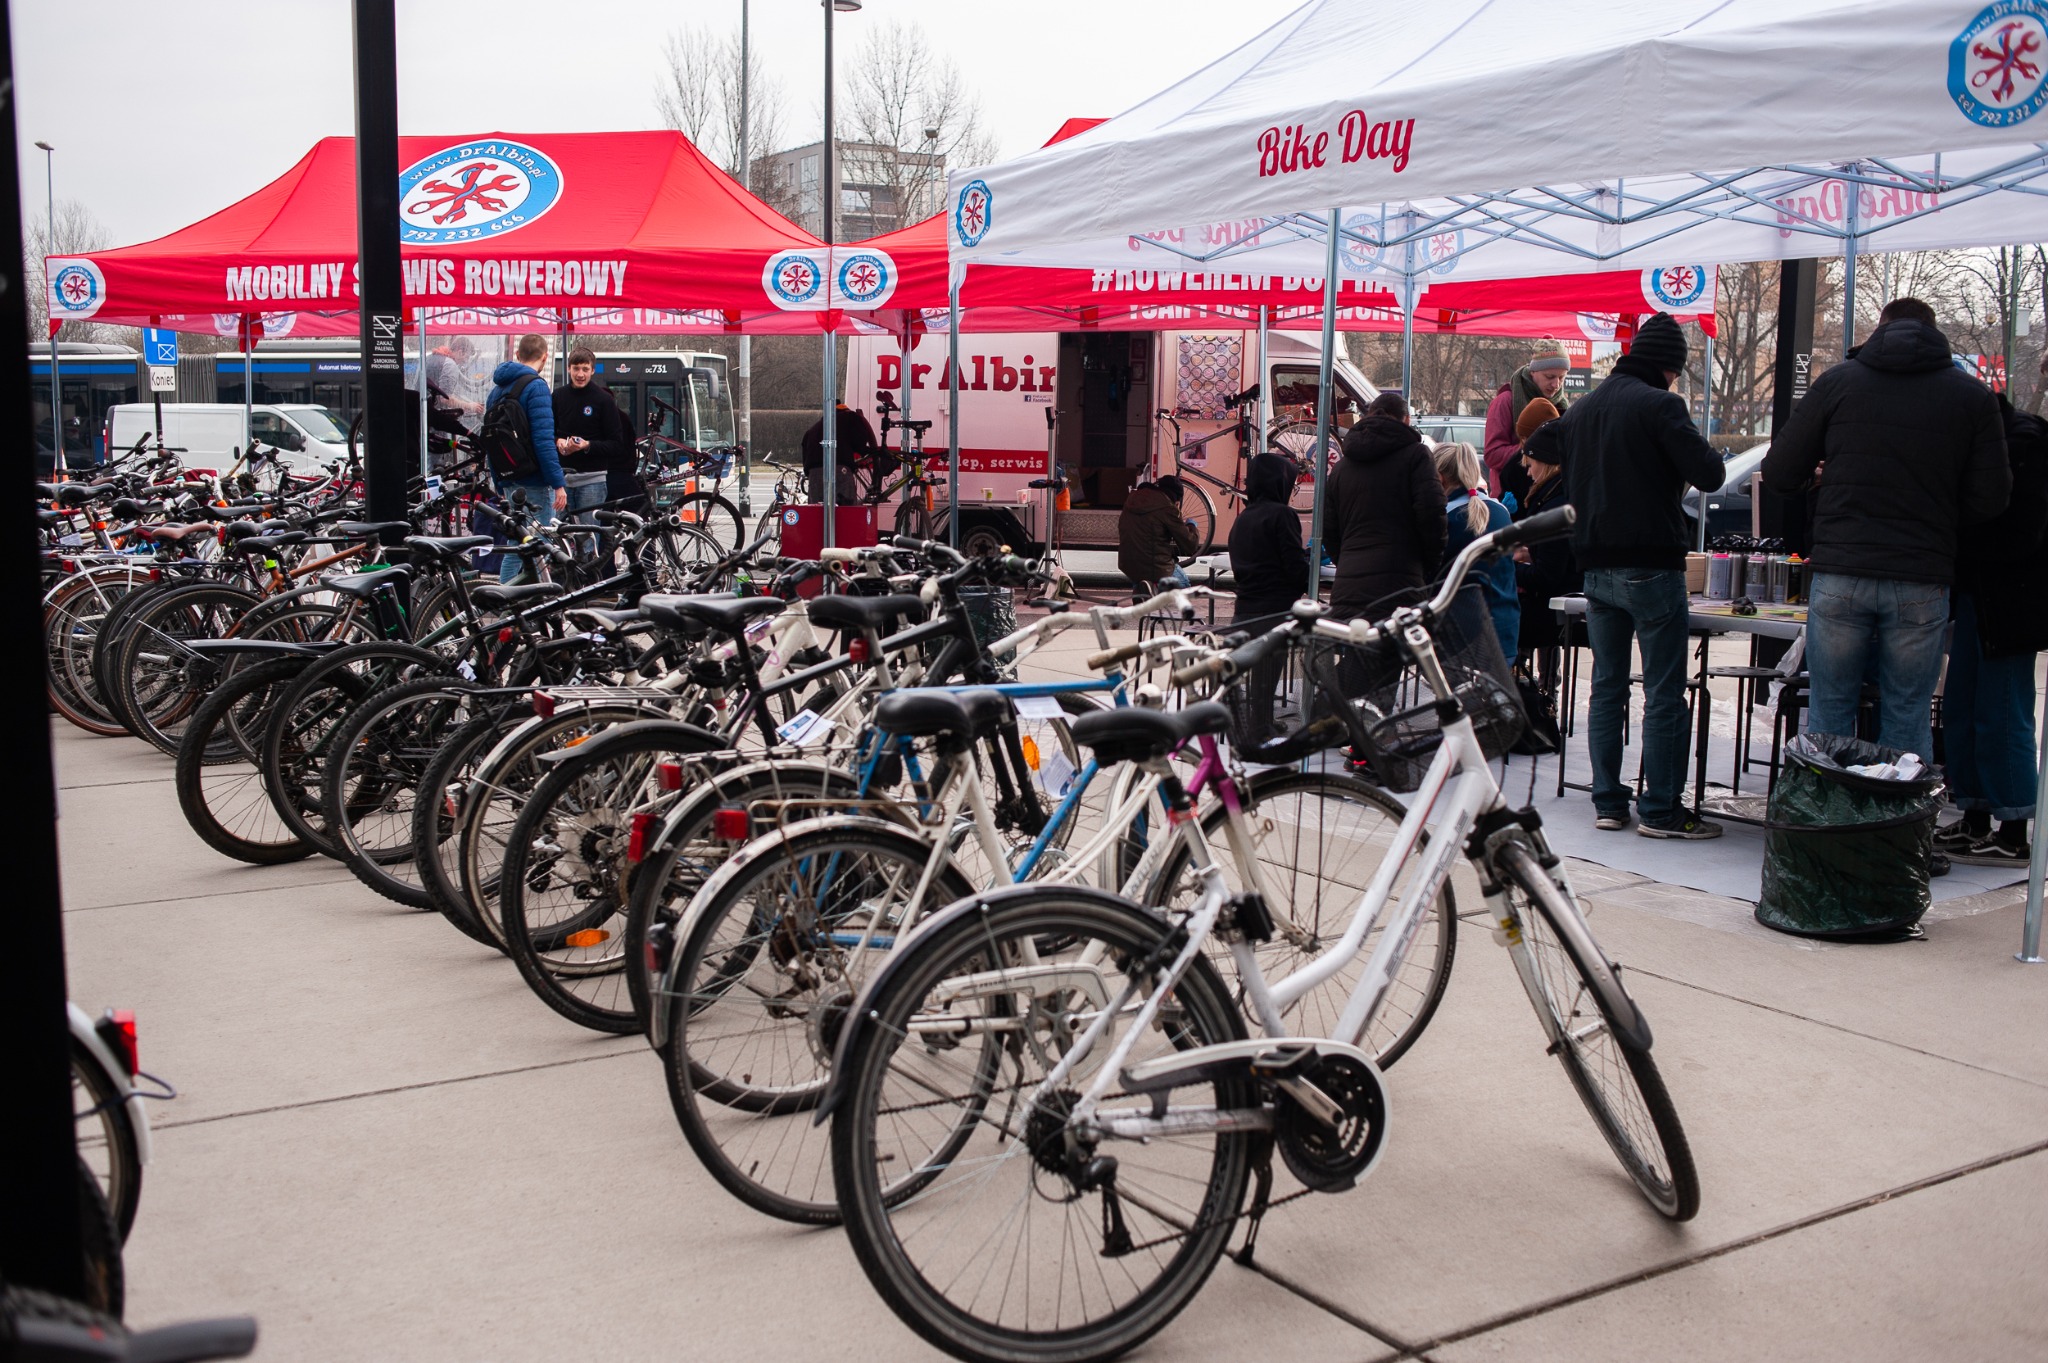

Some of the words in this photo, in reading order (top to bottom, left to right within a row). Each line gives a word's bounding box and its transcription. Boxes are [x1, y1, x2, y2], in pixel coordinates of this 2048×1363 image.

[1979, 110, 2002, 124] 792
[2007, 104, 2031, 123] 232
[1257, 124, 1329, 177] Bike
[1338, 109, 1415, 173] Day
[410, 144, 547, 181] www.DrAlbin.pl
[402, 229, 439, 241] 792
[444, 227, 483, 240] 232
[490, 214, 525, 231] 666
[226, 262, 344, 301] MOBILNY
[464, 260, 628, 296] ROWEROWY
[151, 371, 174, 387] Koniec
[340, 364, 361, 372] biletowy
[877, 355, 932, 389] Dr
[990, 456, 1043, 469] serwis
